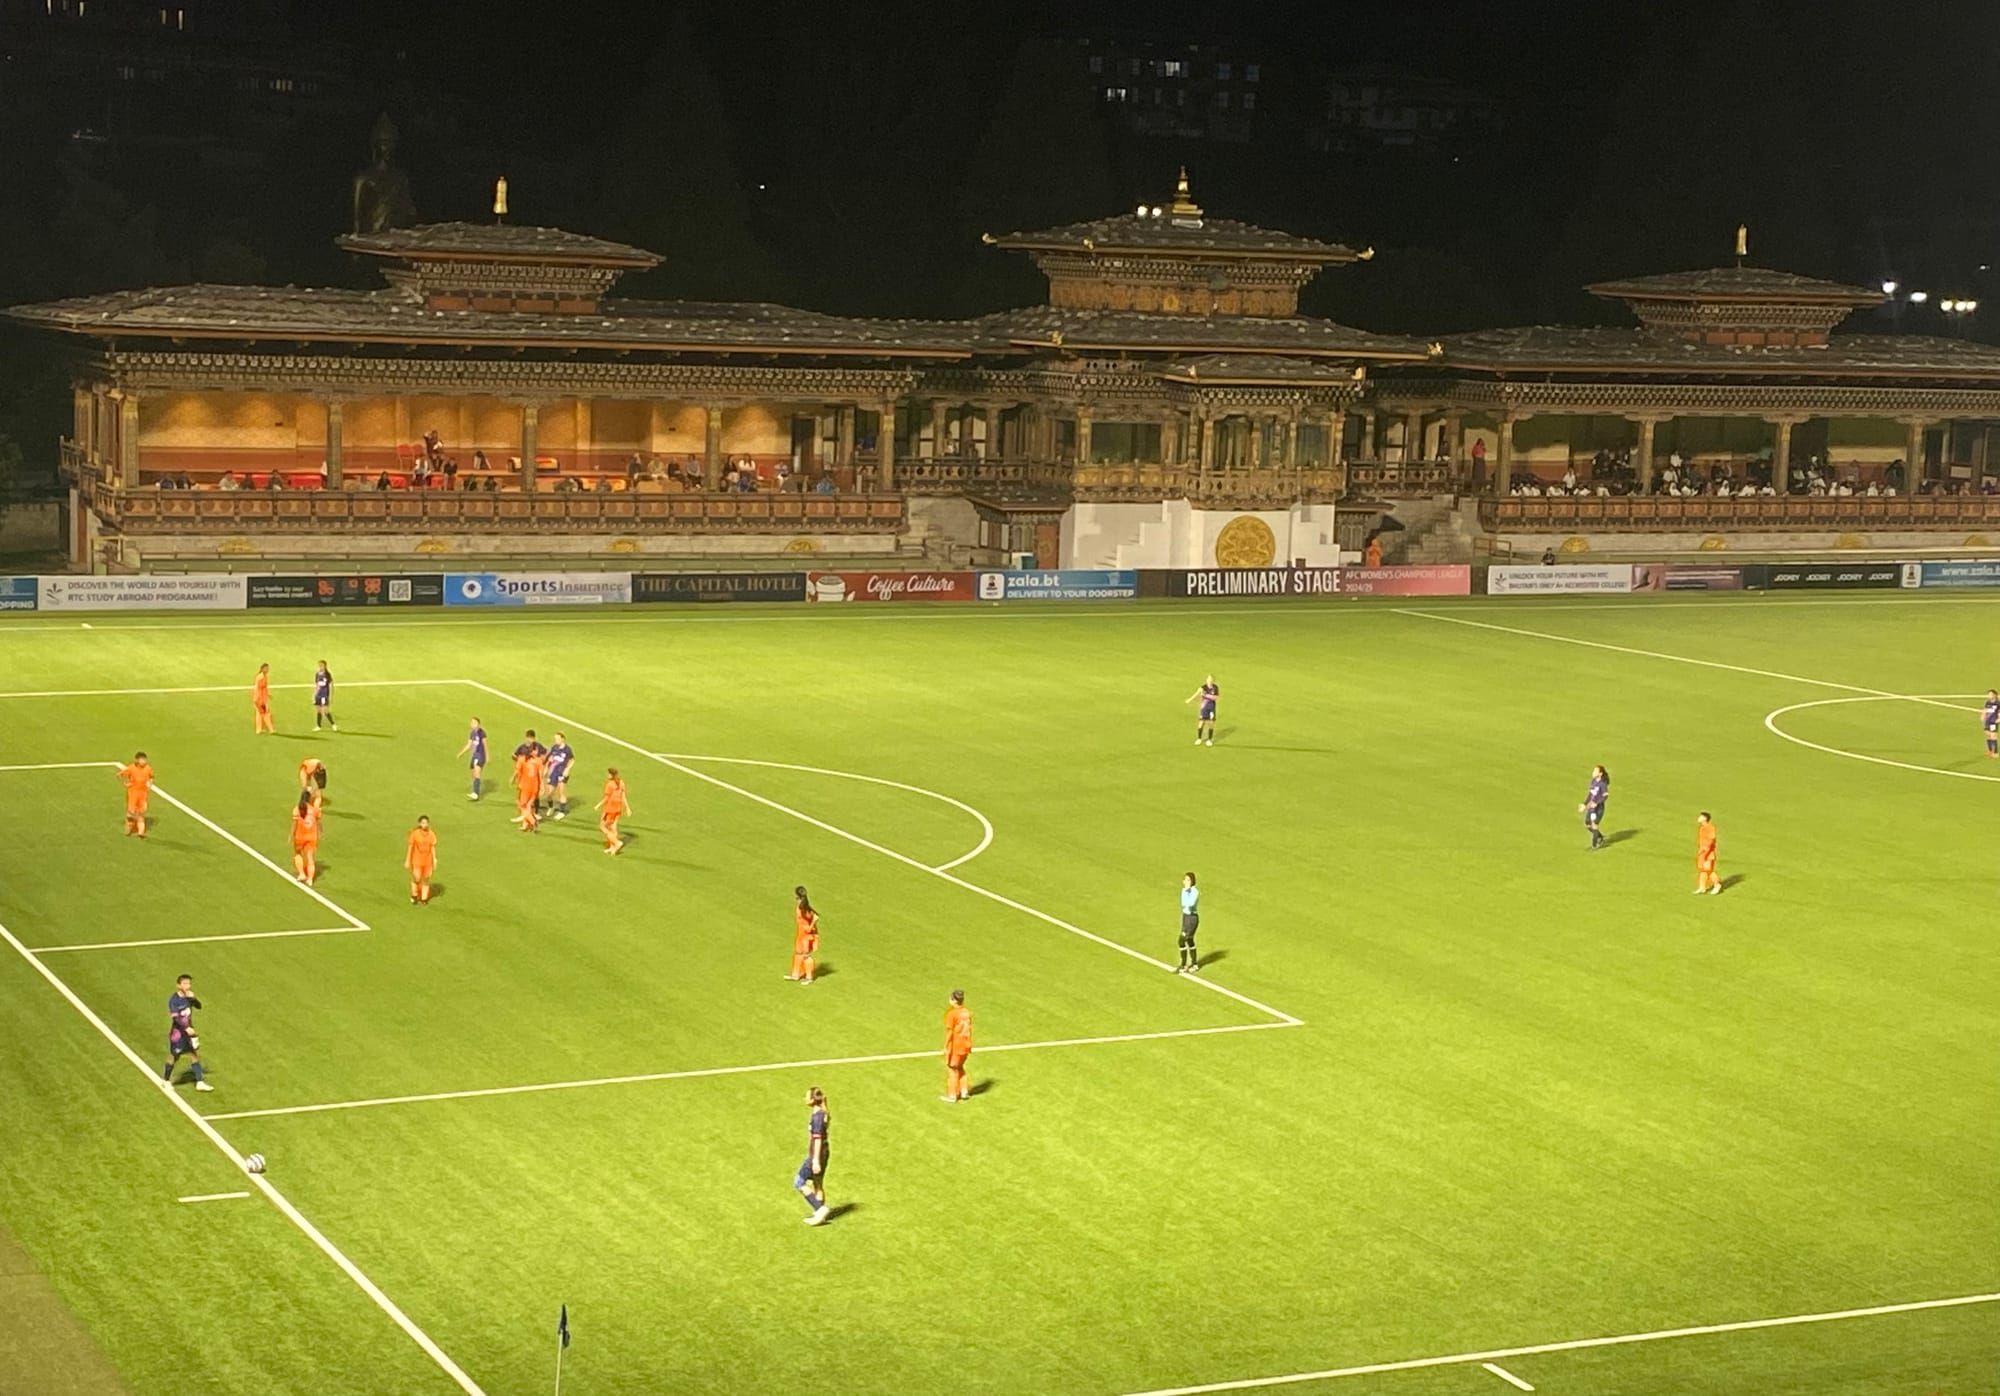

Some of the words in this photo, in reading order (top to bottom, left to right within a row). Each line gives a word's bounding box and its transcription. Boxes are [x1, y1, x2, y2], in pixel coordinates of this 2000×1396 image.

[1007, 574, 1060, 587] zala.bt
[1345, 571, 1360, 580] AFC
[1360, 571, 1394, 580] WOMEN'S
[1395, 570, 1436, 579] CHAMPIONS
[1438, 569, 1465, 579] LEAGUE
[68, 581, 108, 590] DISCOVER
[110, 581, 125, 590] THE
[127, 581, 157, 590] WORLD
[159, 581, 177, 589] AND
[179, 581, 216, 589] YOURSELF
[219, 580, 241, 589] WITH
[497, 579, 557, 595] Sports
[560, 581, 624, 593] Insurance
[639, 578, 671, 592] THE
[675, 578, 744, 592] CAPITAL
[747, 576, 801, 592] HOTEL
[867, 575, 905, 601] Coffee
[907, 575, 955, 592] Culture
[1187, 571, 1288, 595] PRELIMINARY
[1294, 570, 1341, 593] STAGE
[117, 593, 154, 601] ABROAD
[1007, 590, 1048, 598] DELIVERY
[1050, 590, 1061, 598] TO
[1063, 589, 1087, 598] YOUR
[1088, 589, 1135, 597] DOORSTEP
